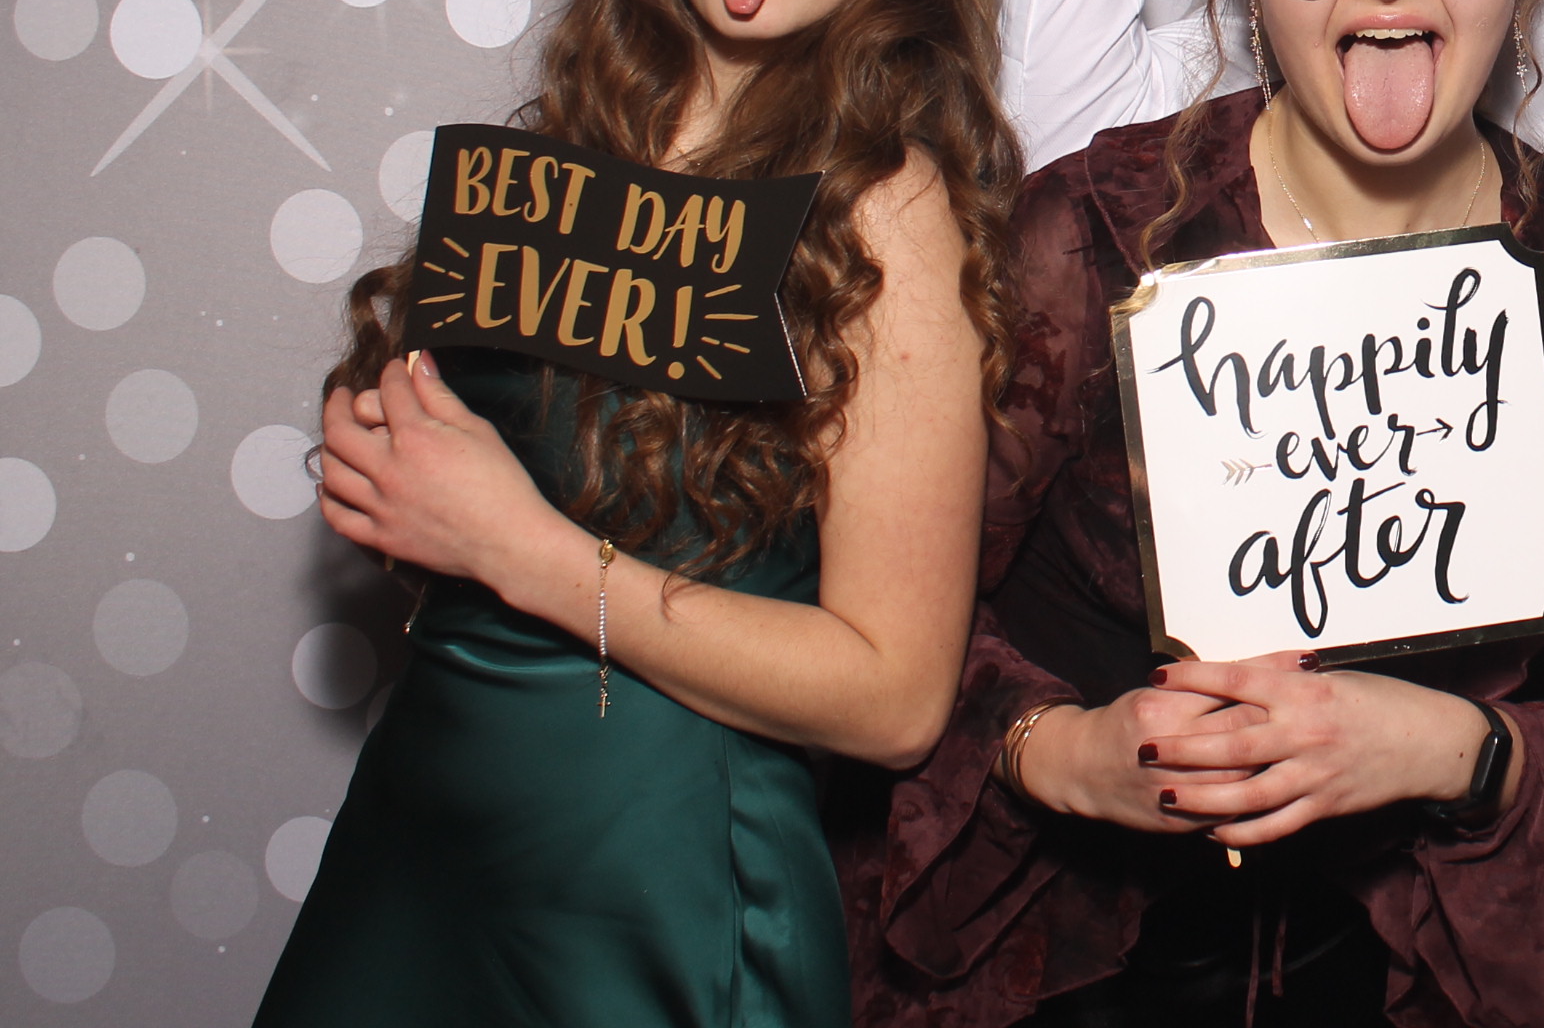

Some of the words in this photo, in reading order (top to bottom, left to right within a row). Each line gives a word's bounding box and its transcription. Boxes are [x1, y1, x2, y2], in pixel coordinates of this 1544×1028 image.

[454, 146, 596, 234] BEST
[616, 183, 746, 273] DAY
[474, 242, 694, 379] EVER!
[1147, 268, 1510, 452] happily
[1276, 413, 1417, 481] ever
[1228, 478, 1469, 638] after
